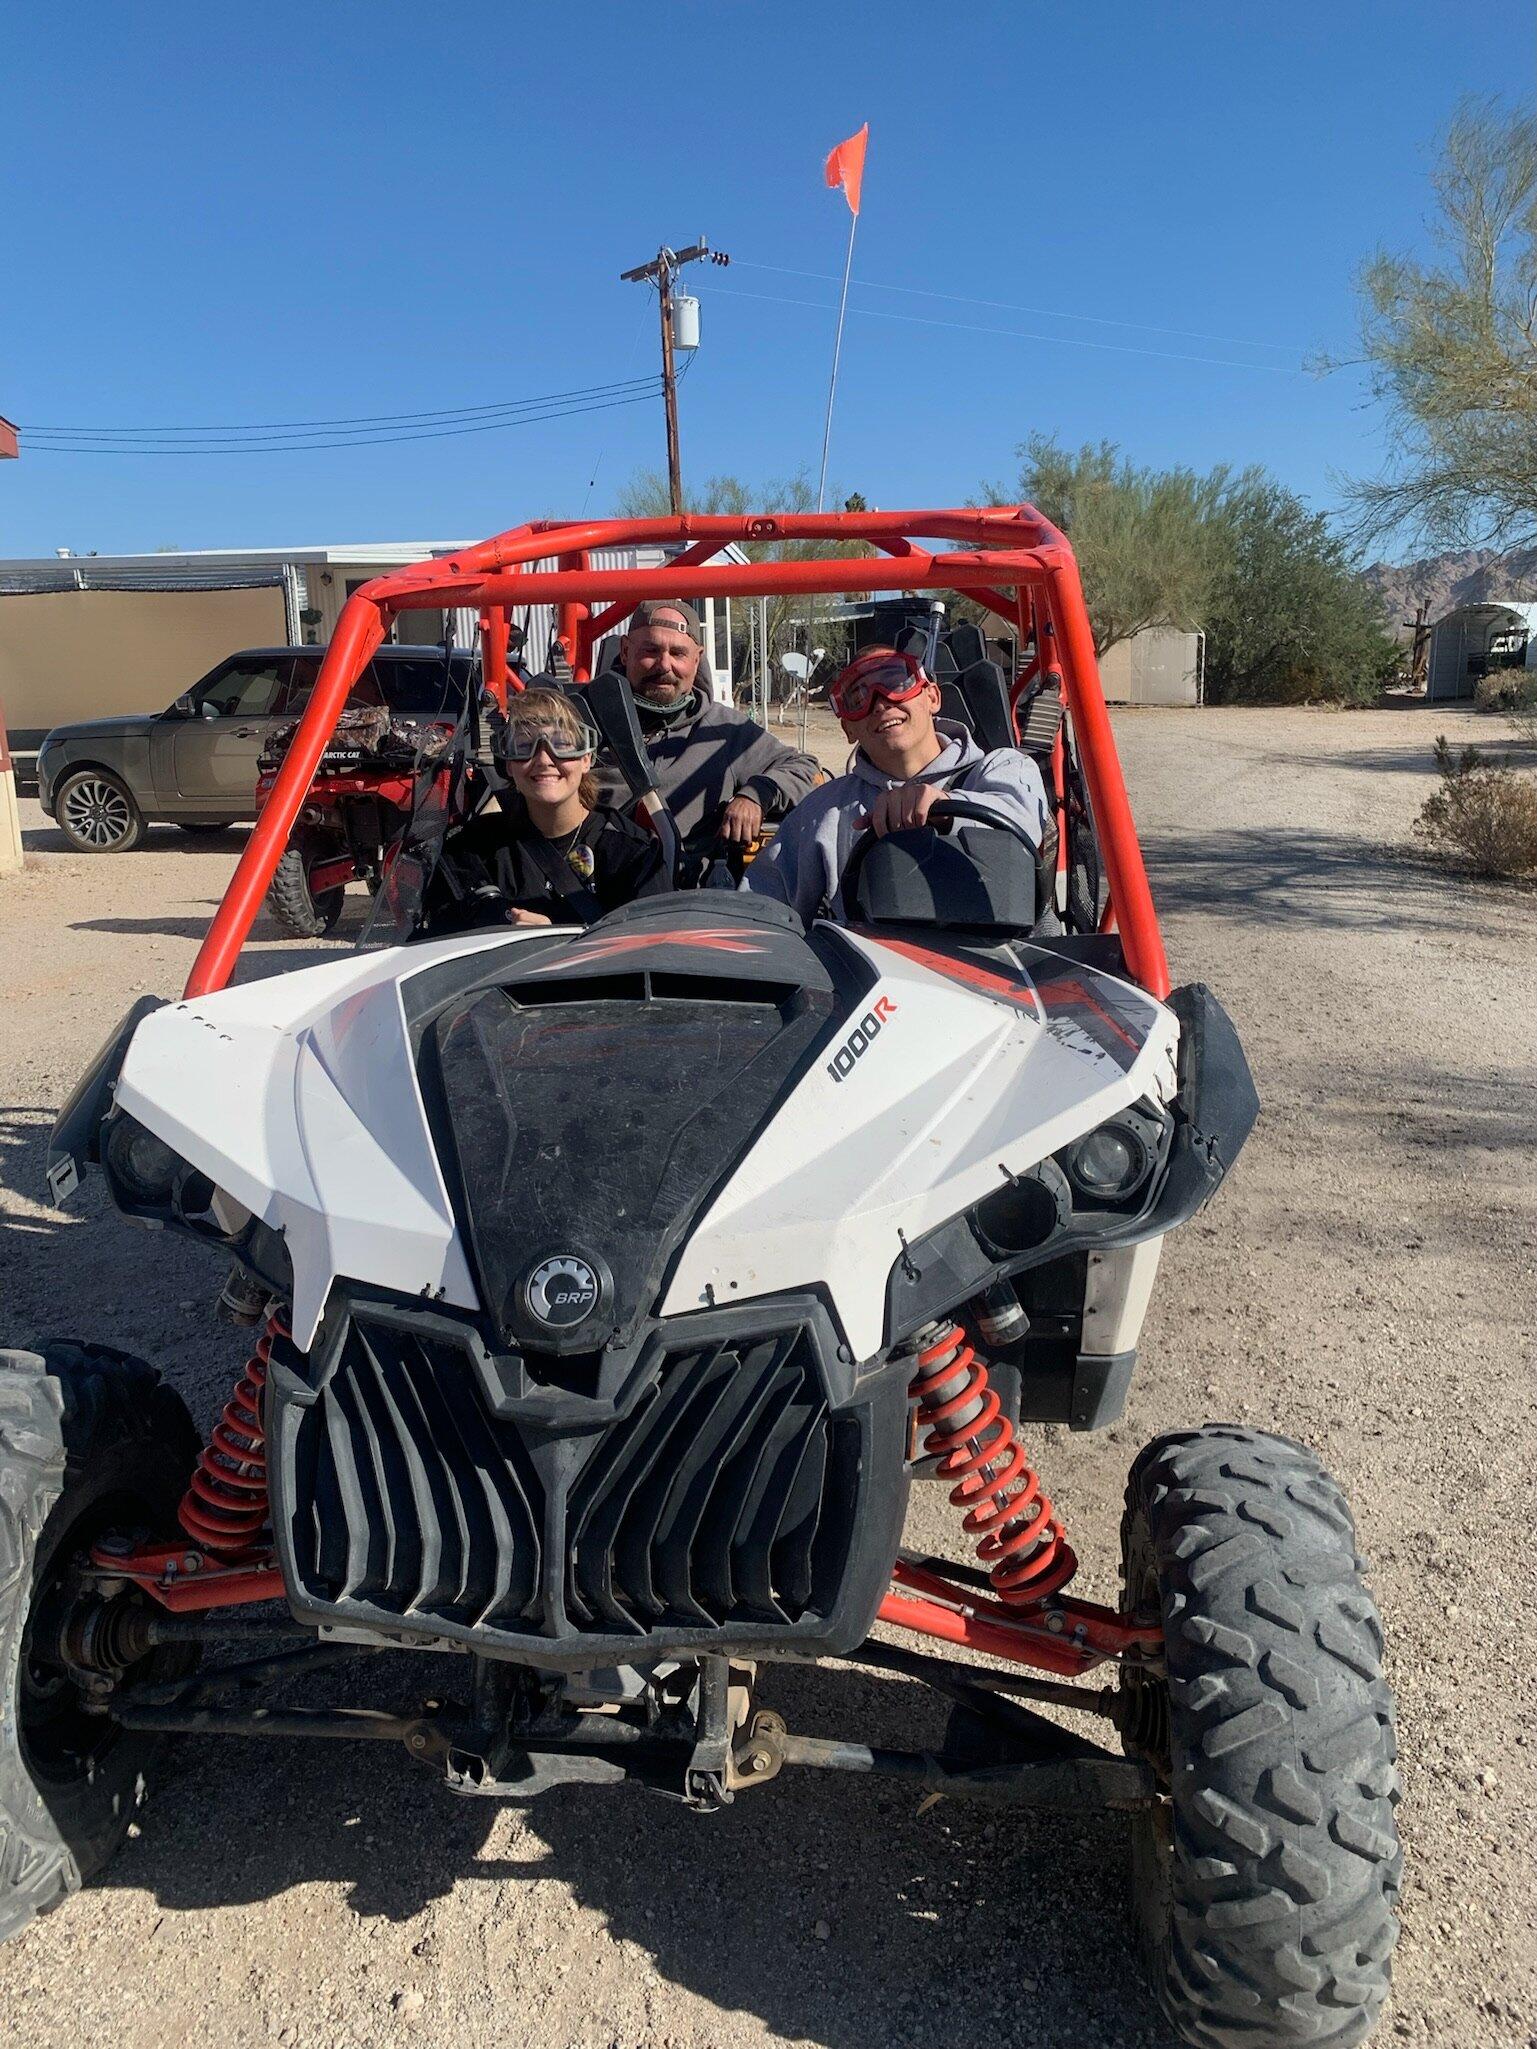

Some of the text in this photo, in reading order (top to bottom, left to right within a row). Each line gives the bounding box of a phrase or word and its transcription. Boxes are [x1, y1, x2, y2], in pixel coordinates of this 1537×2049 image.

[323, 751, 361, 759] ARCTIC CAT
[826, 995, 898, 1083] 1000R
[554, 1291, 594, 1305] BRP
